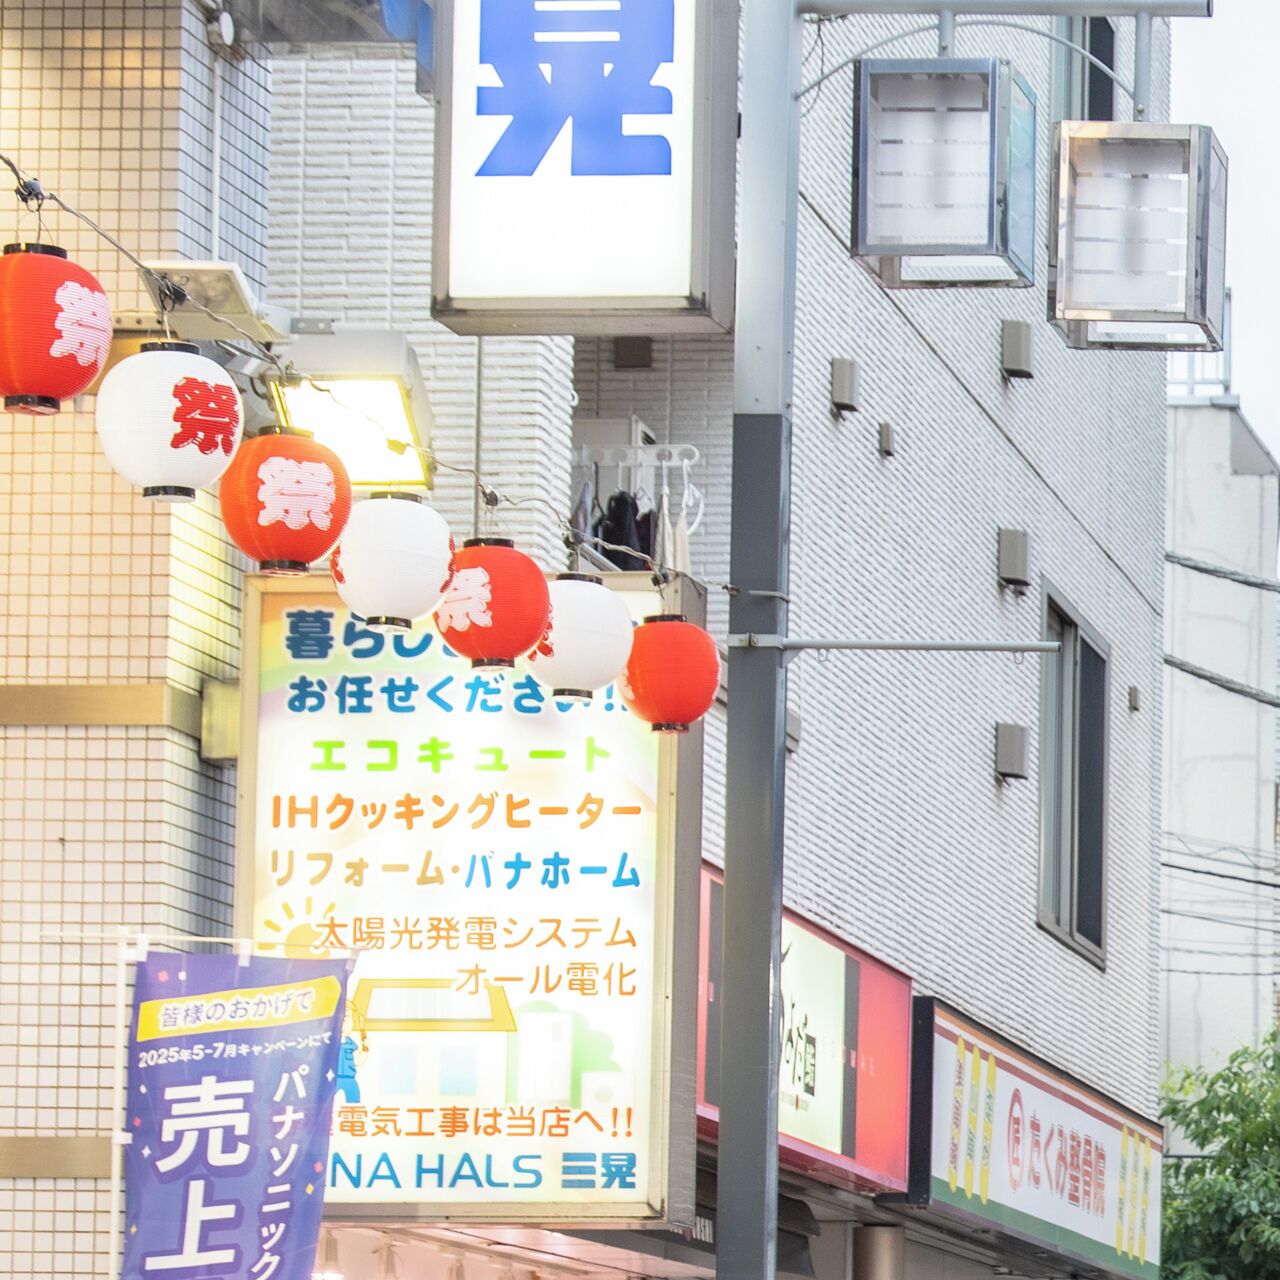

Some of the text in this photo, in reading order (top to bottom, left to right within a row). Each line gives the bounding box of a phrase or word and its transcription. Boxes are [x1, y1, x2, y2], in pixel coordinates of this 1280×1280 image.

[170, 377, 240, 455] 祭
[257, 456, 336, 531] 祭
[310, 736, 611, 773] エコキュート
[272, 792, 642, 829] IHクッキングヒーター
[270, 850, 641, 890] リフォーム・パナホーム
[315, 916, 637, 951] 太陽光発電システム
[455, 962, 637, 997] オール電化
[161, 990, 313, 1028] 皆様のおかげで
[332, 1105, 634, 1138] 電気工事は当店へ!!
[416, 1153, 542, 1189] HALS
[561, 1153, 637, 1189] 三晃
[1029, 1109, 1106, 1219] たくみ整骨院
